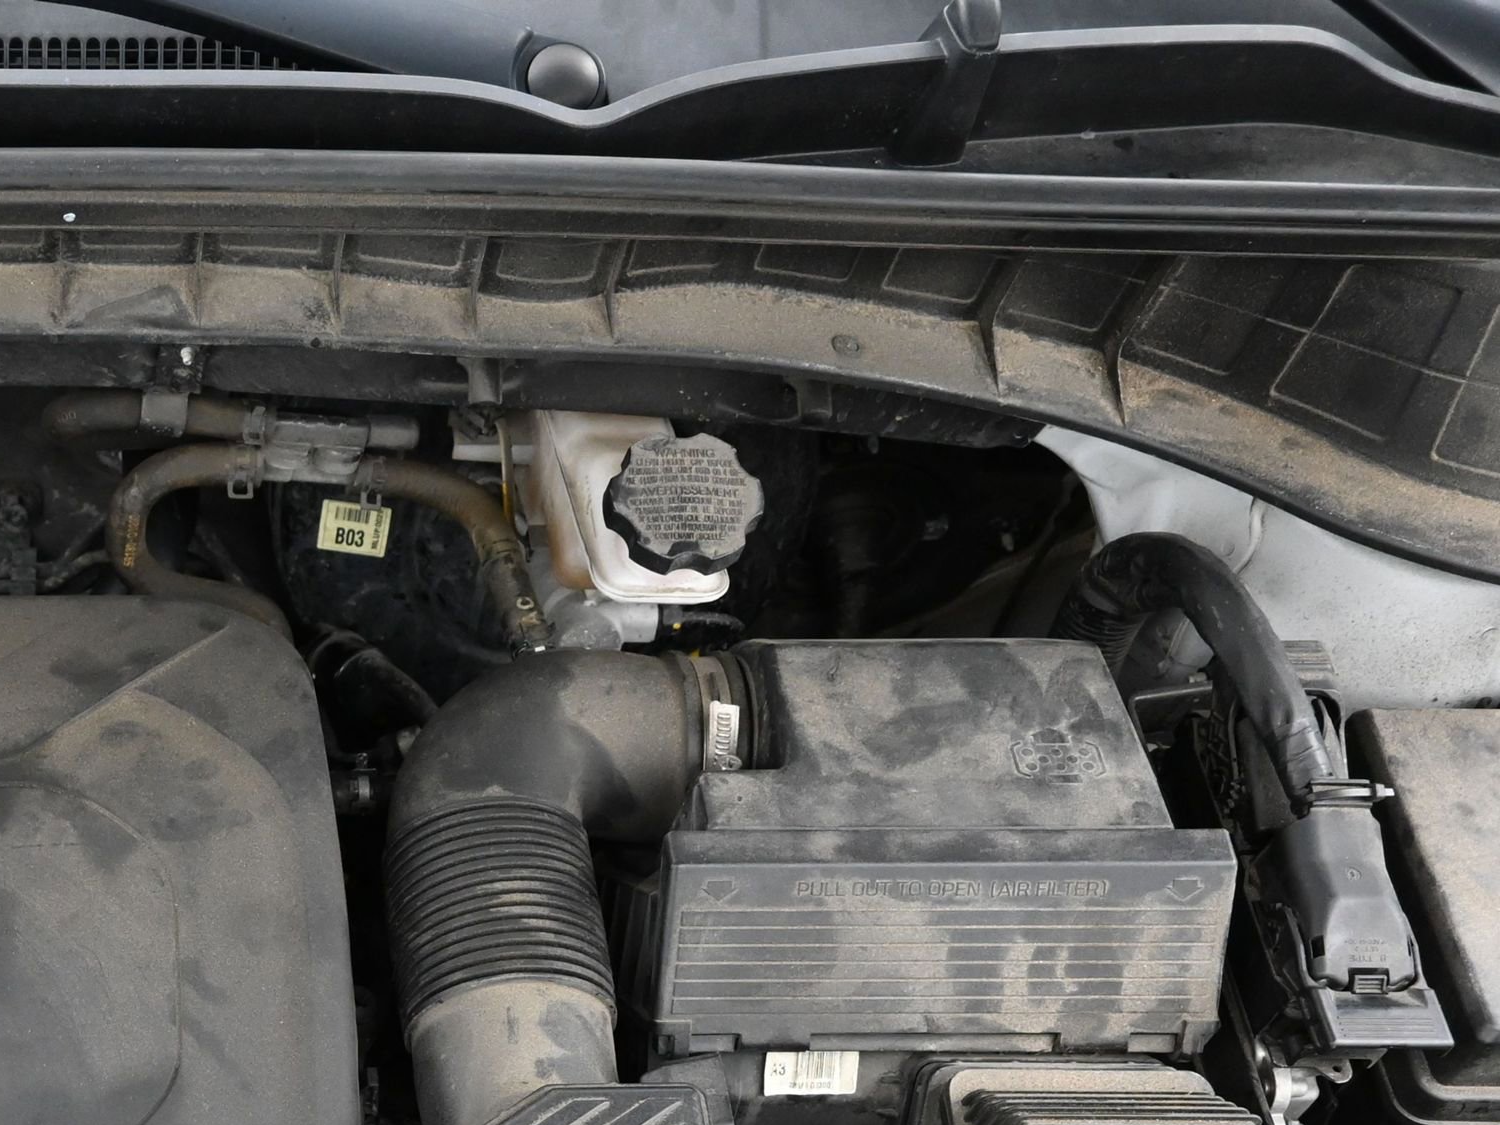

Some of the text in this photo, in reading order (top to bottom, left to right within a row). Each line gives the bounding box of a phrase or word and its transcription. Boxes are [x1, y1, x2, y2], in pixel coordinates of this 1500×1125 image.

[654, 448, 716, 458] WARNING
[641, 485, 739, 498] AVERTISSEMENT
[335, 526, 365, 548] B03
[796, 880, 1109, 898] PULL OUT TO OPEN (AIR FILTER)
